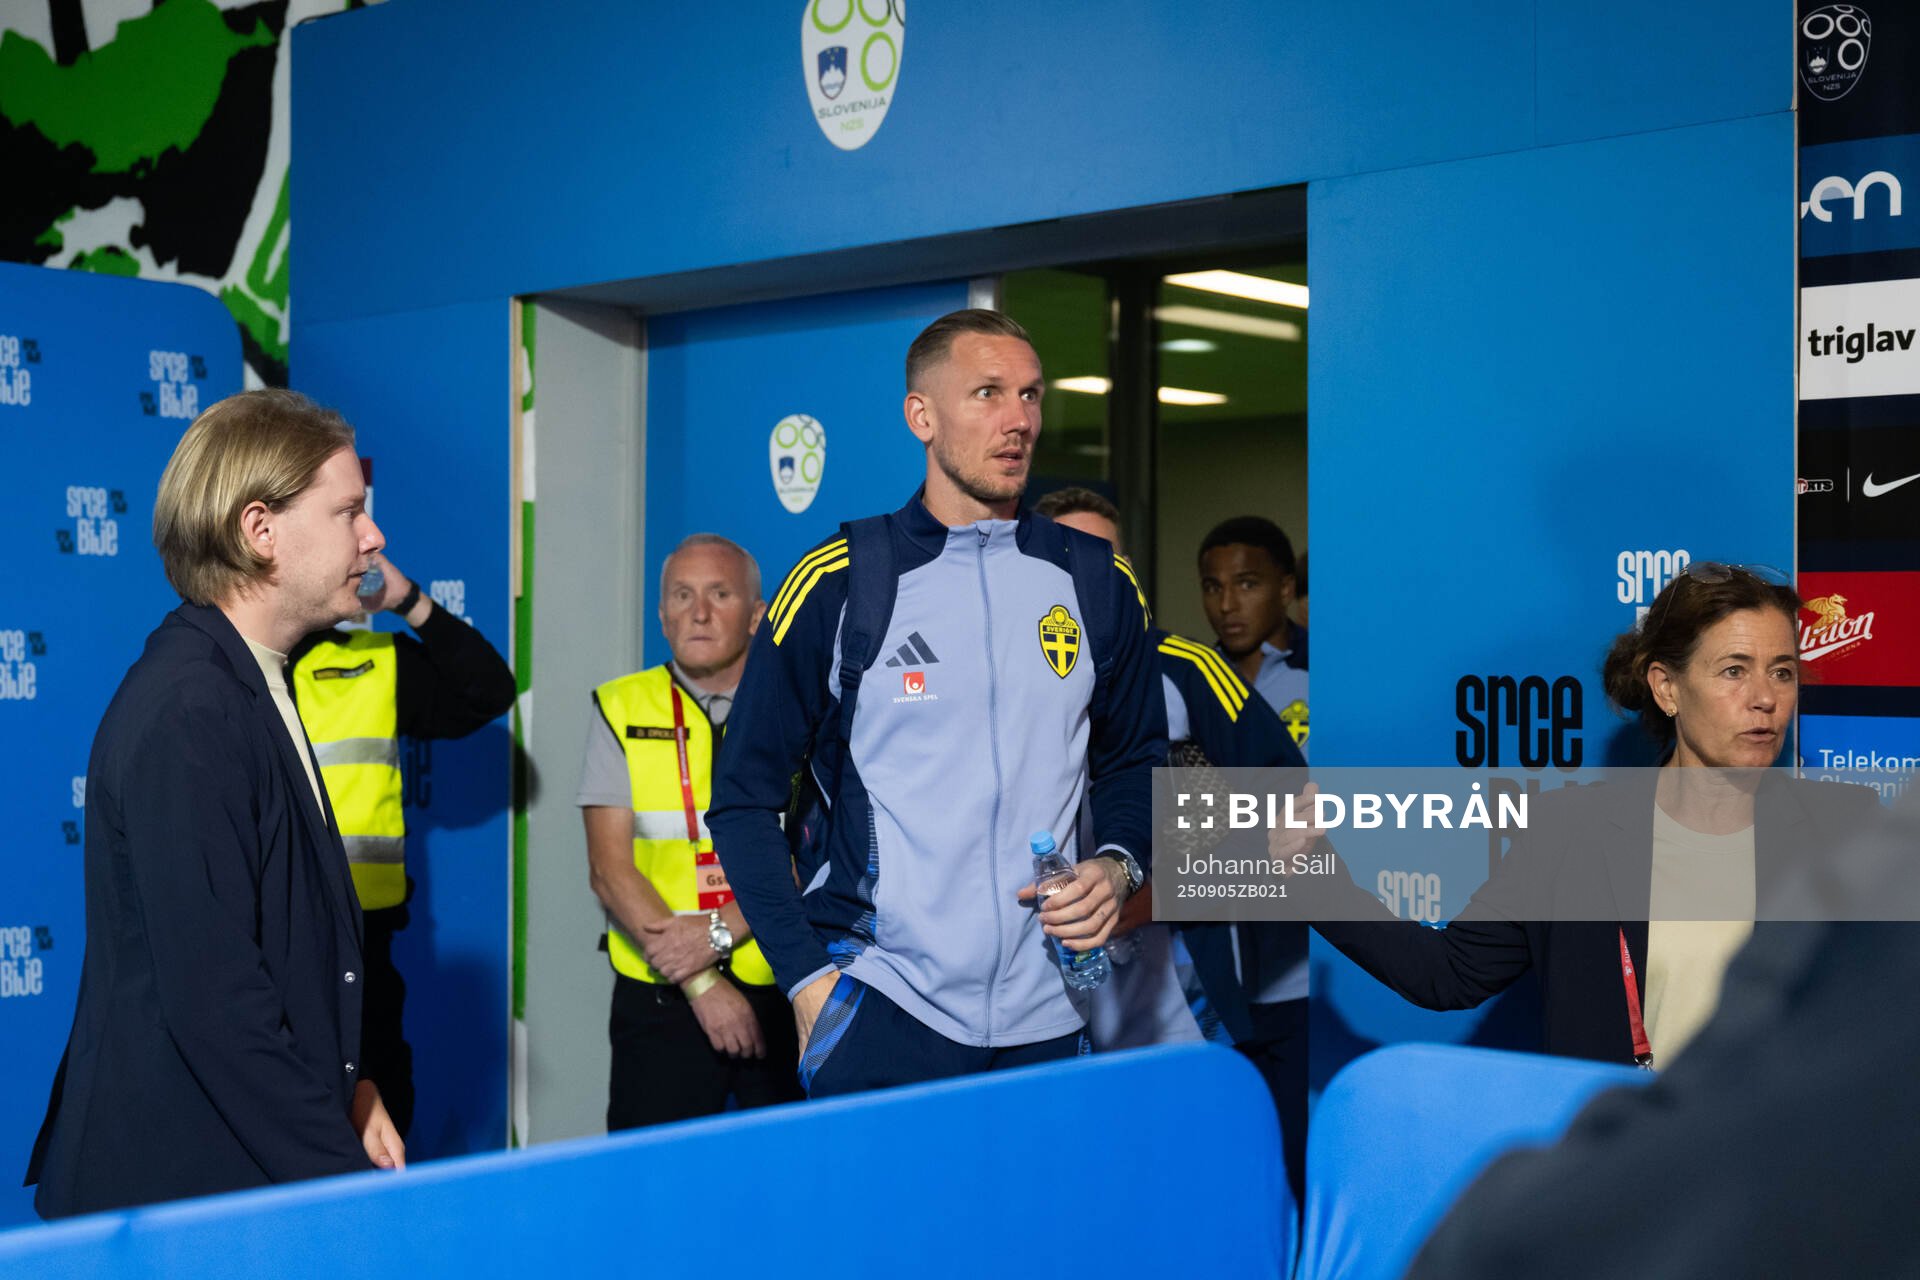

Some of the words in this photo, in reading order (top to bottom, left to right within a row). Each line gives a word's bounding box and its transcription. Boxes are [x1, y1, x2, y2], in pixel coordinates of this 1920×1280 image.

[818, 97, 886, 118] SLOVENIJA
[1808, 323, 1916, 363] triglav
[1046, 625, 1073, 635] SVERIGE
[1456, 675, 1583, 773] srce
